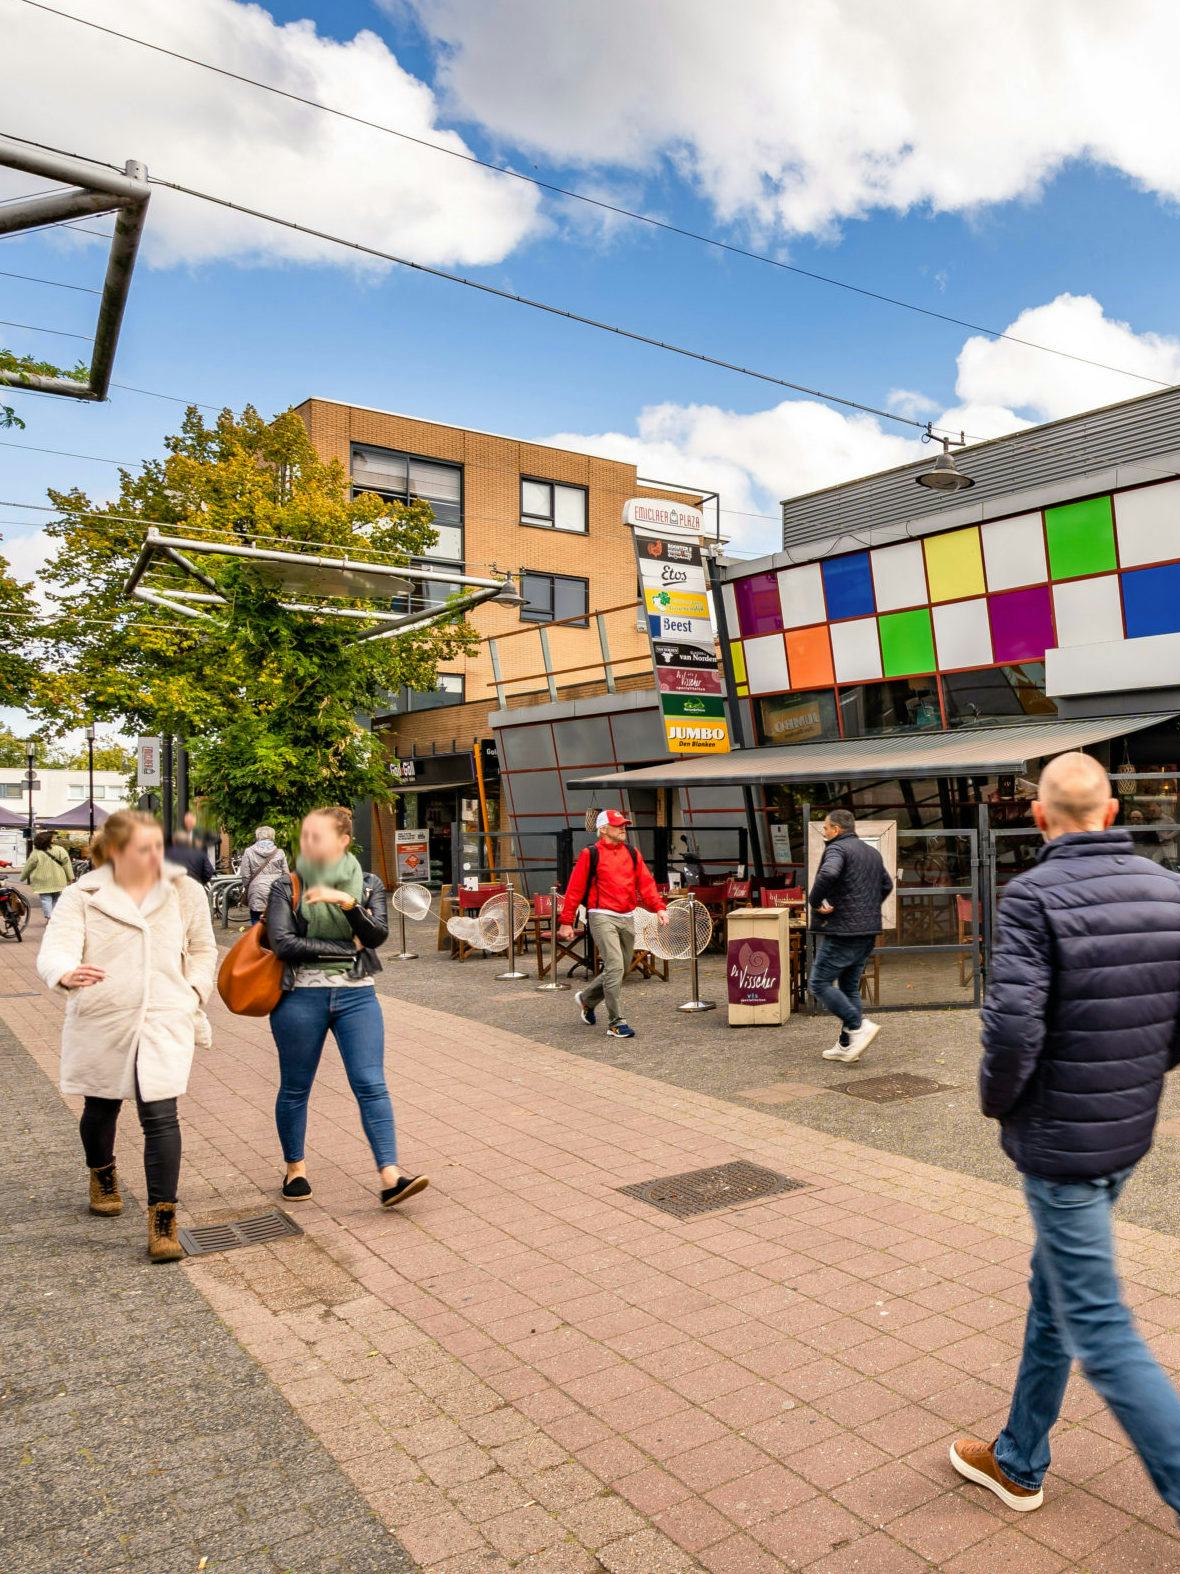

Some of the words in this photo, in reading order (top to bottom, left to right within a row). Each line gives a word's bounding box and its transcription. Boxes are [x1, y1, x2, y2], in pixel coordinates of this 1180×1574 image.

[635, 506, 669, 523] EMICLAER
[679, 513, 700, 529] PLAZA
[661, 565, 687, 581] Etos
[663, 618, 692, 632] Beest
[680, 654, 692, 662] van
[693, 654, 717, 663] Norden
[667, 727, 725, 740] JUMBO
[740, 965, 776, 990] Visscher
